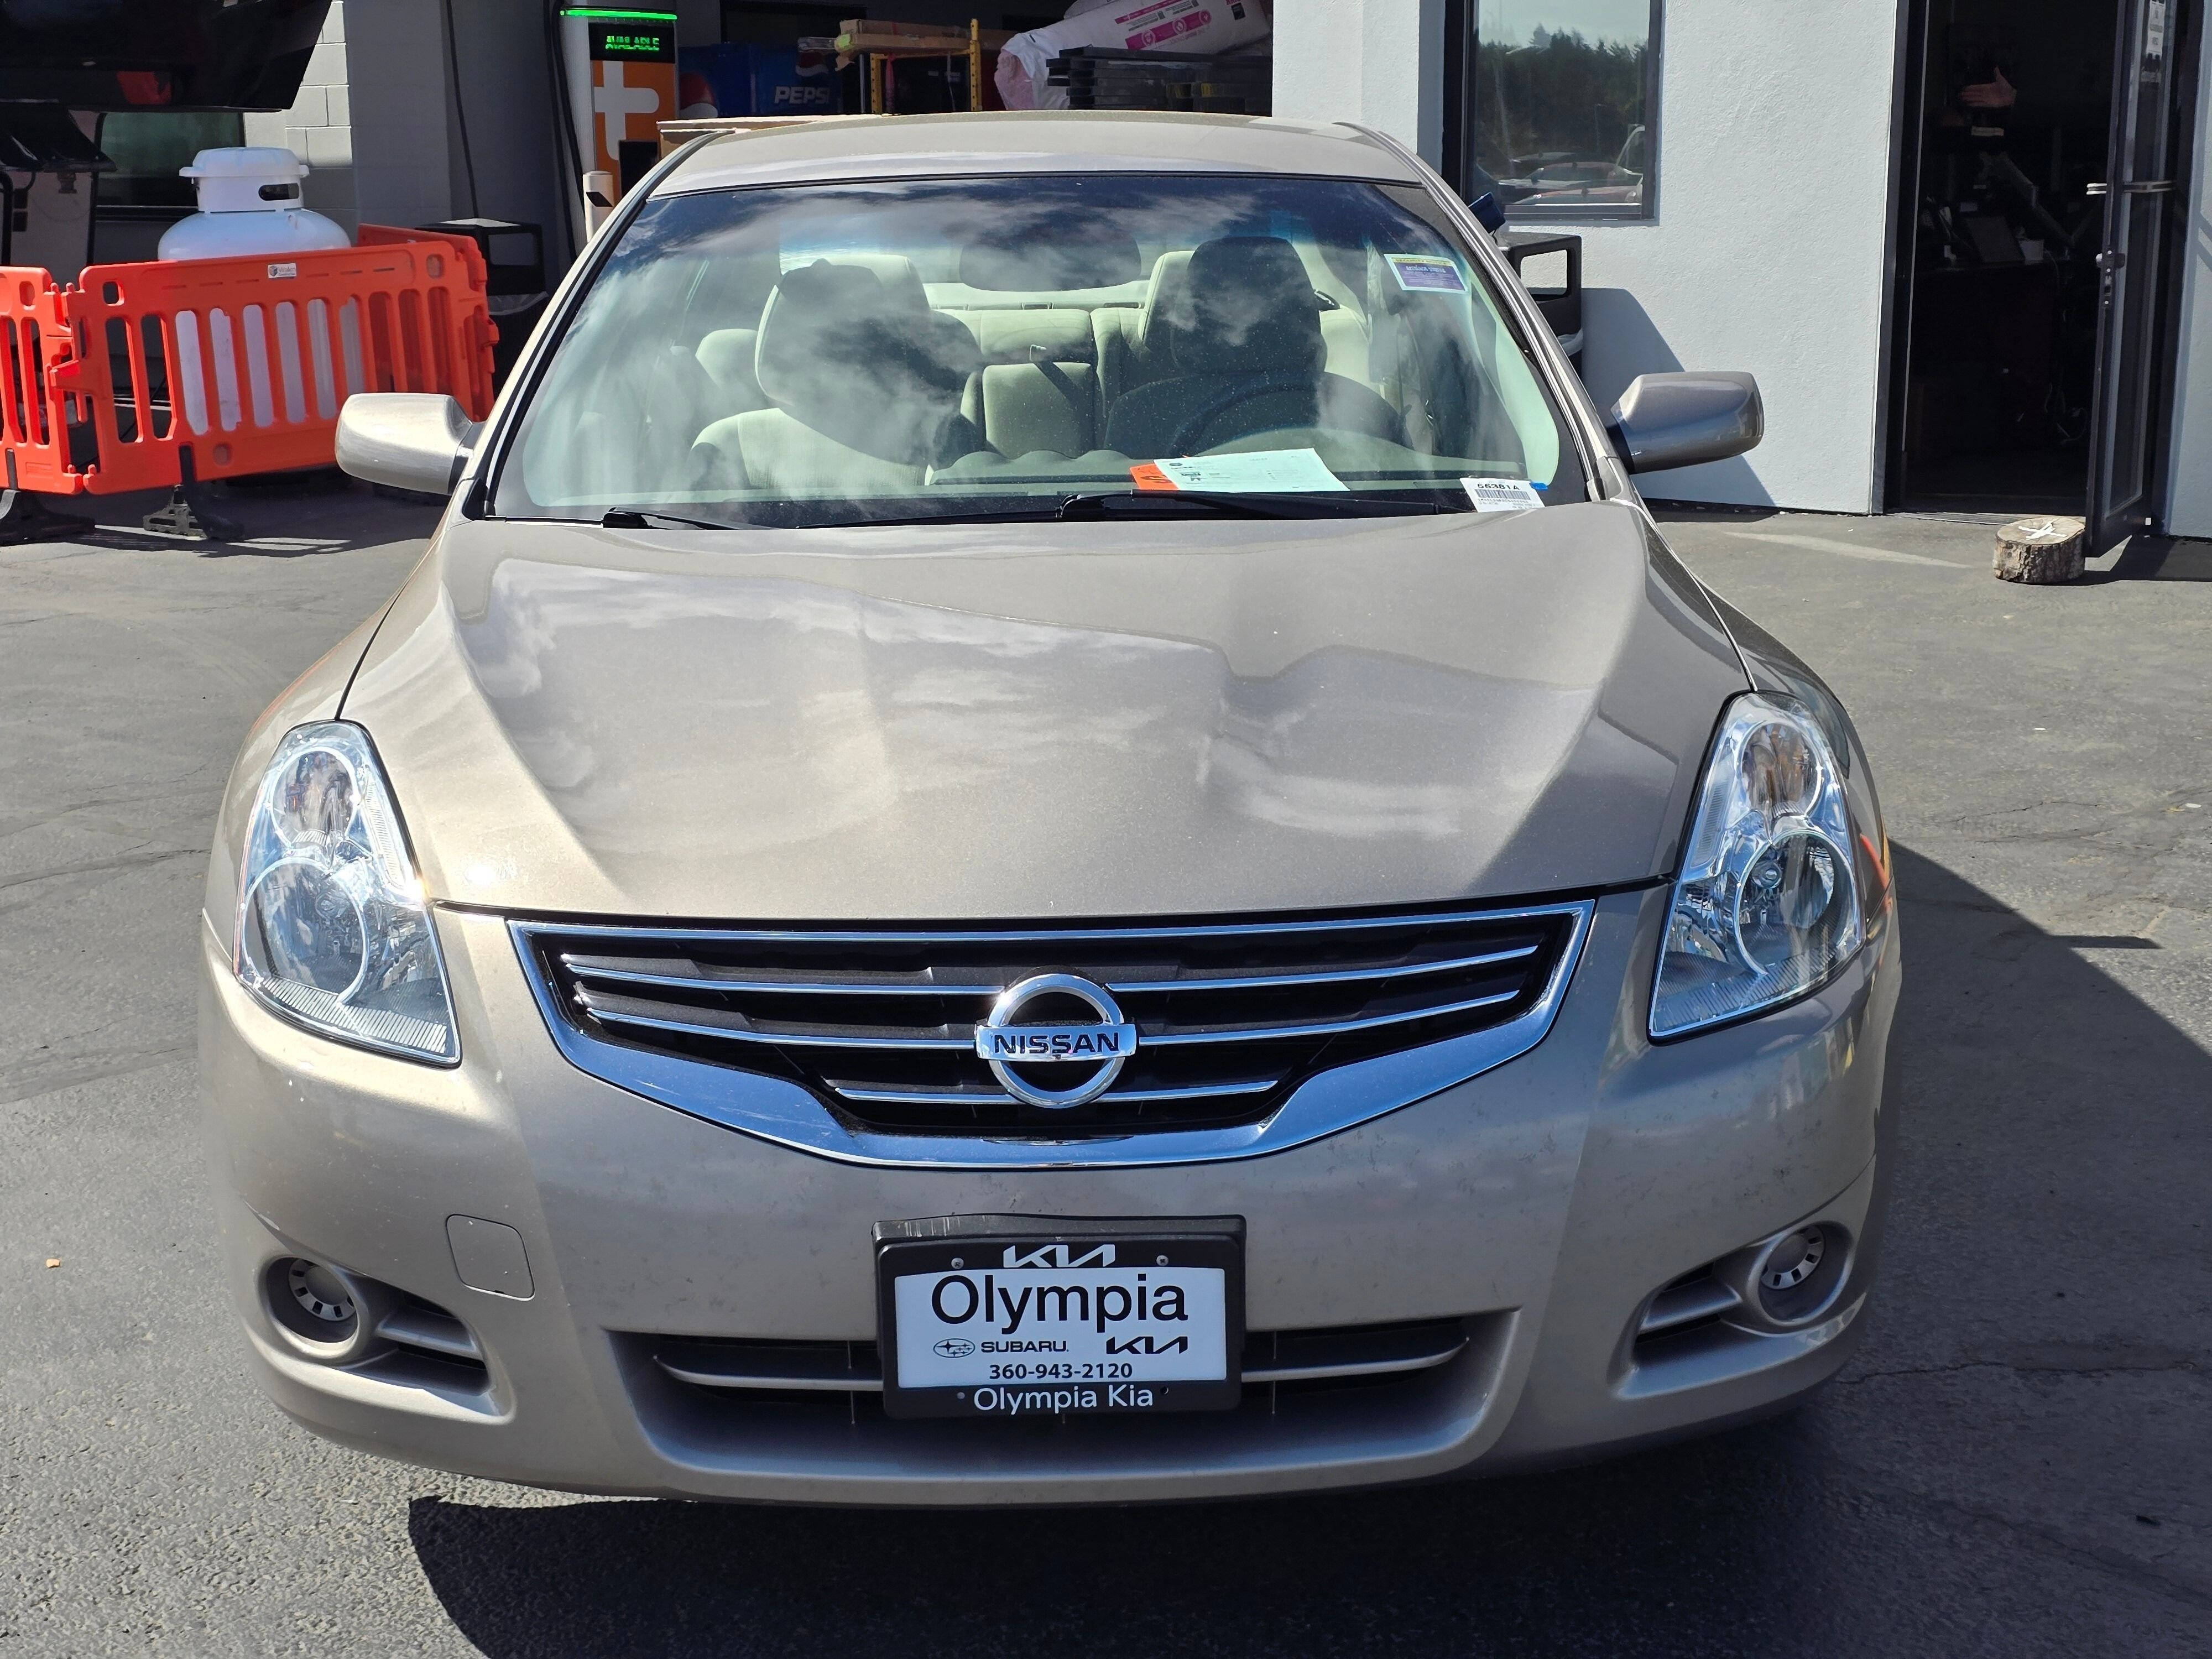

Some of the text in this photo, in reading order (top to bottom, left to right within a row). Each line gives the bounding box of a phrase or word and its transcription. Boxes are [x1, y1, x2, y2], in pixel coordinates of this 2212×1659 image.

[994, 1032, 1120, 1054] NISSAN
[1003, 1244, 1115, 1268] KIA
[931, 1274, 1188, 1335] Olympia
[980, 1340, 1067, 1353] SUBARU
[1106, 1335, 1188, 1355] KIA
[989, 1363, 1133, 1380] 360-943-2120
[973, 1384, 1154, 1415] Olympia Kia
